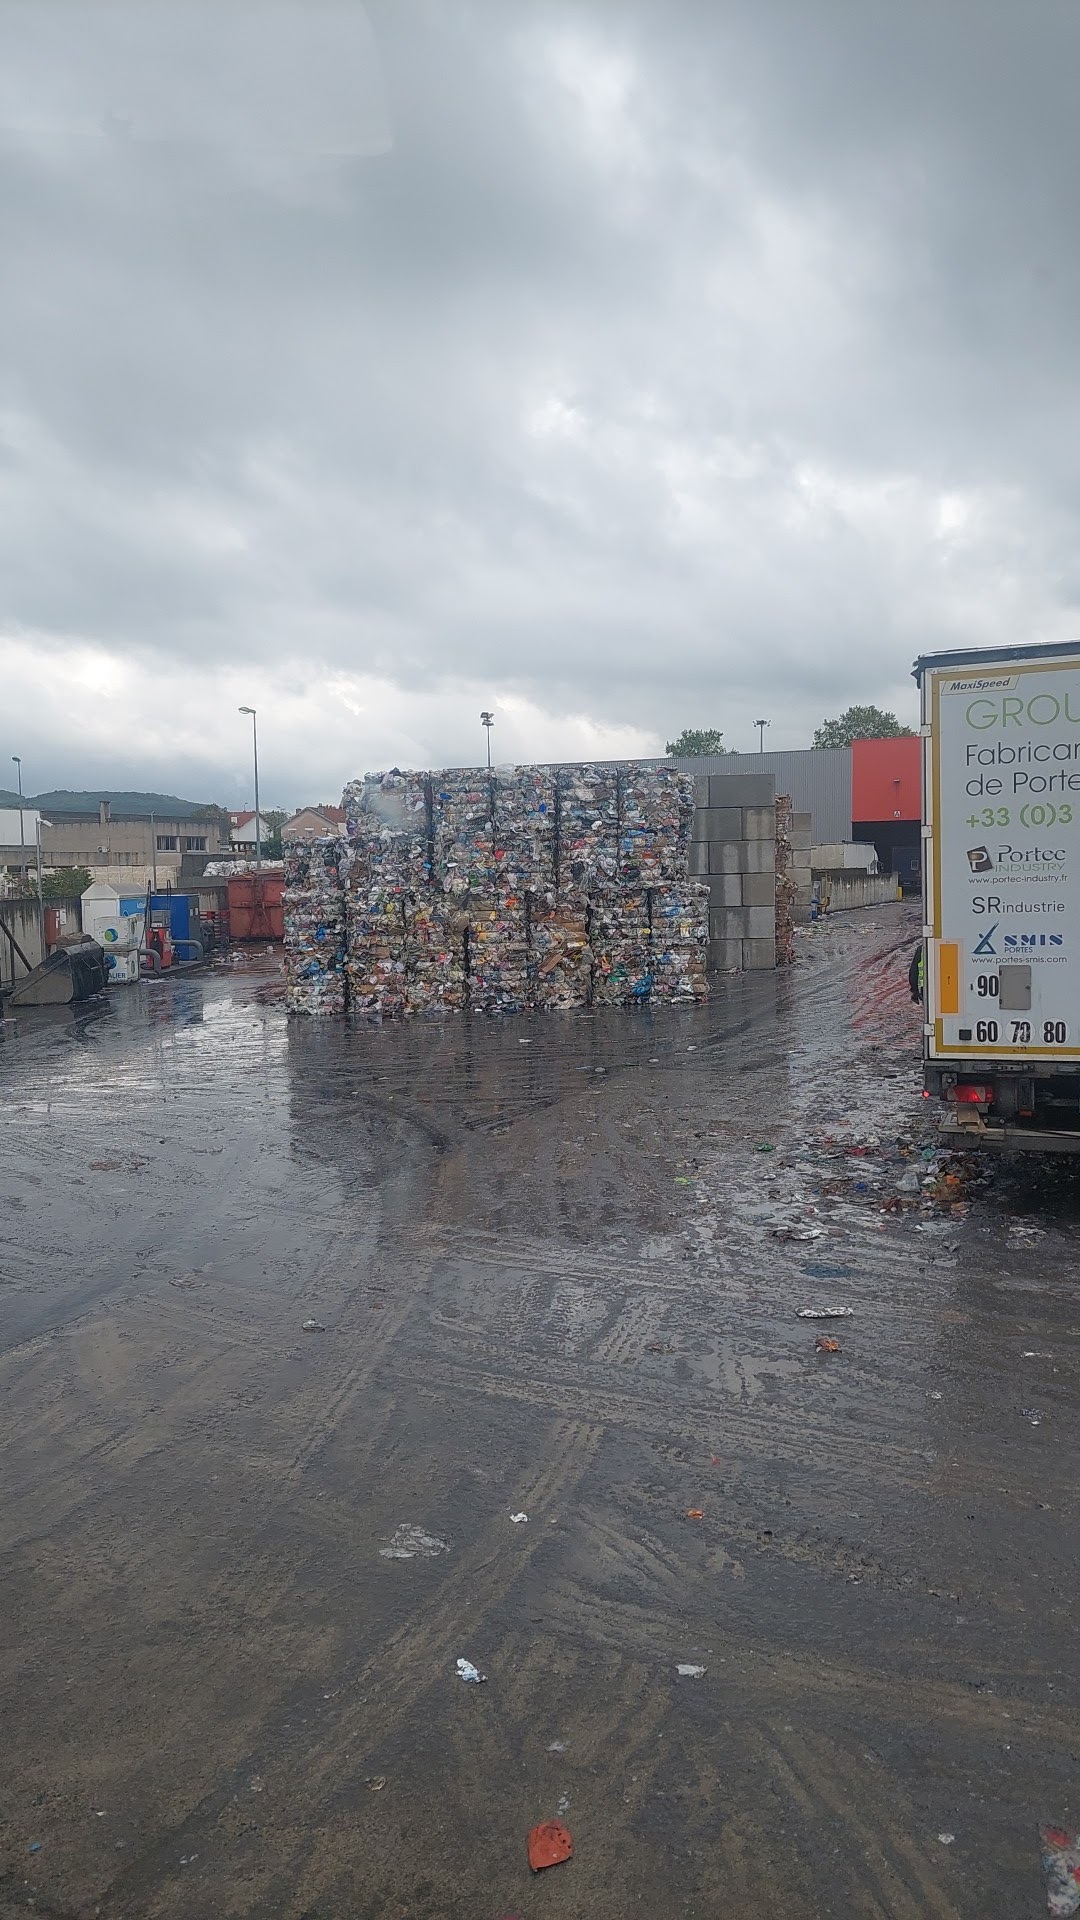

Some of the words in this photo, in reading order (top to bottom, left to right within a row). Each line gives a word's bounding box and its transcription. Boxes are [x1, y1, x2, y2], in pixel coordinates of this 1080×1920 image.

[950, 677, 1010, 691] MaxiSpeed
[965, 693, 1080, 730] GROU
[966, 773, 1003, 796] de
[1013, 769, 1080, 794] Porte
[966, 807, 1010, 828] +33
[1020, 802, 1073, 828] (0)3
[997, 844, 1066, 863] Portec
[995, 862, 1066, 873] INDUSTRY
[968, 874, 1068, 884] www.portec-industry.fr
[1004, 934, 1063, 946] SMIS
[971, 956, 1068, 964] www.portes-smis.com
[977, 975, 999, 997] 90
[976, 1020, 999, 1042] 60
[1010, 1021, 1031, 1043] 70
[1043, 1021, 1066, 1043] 80
